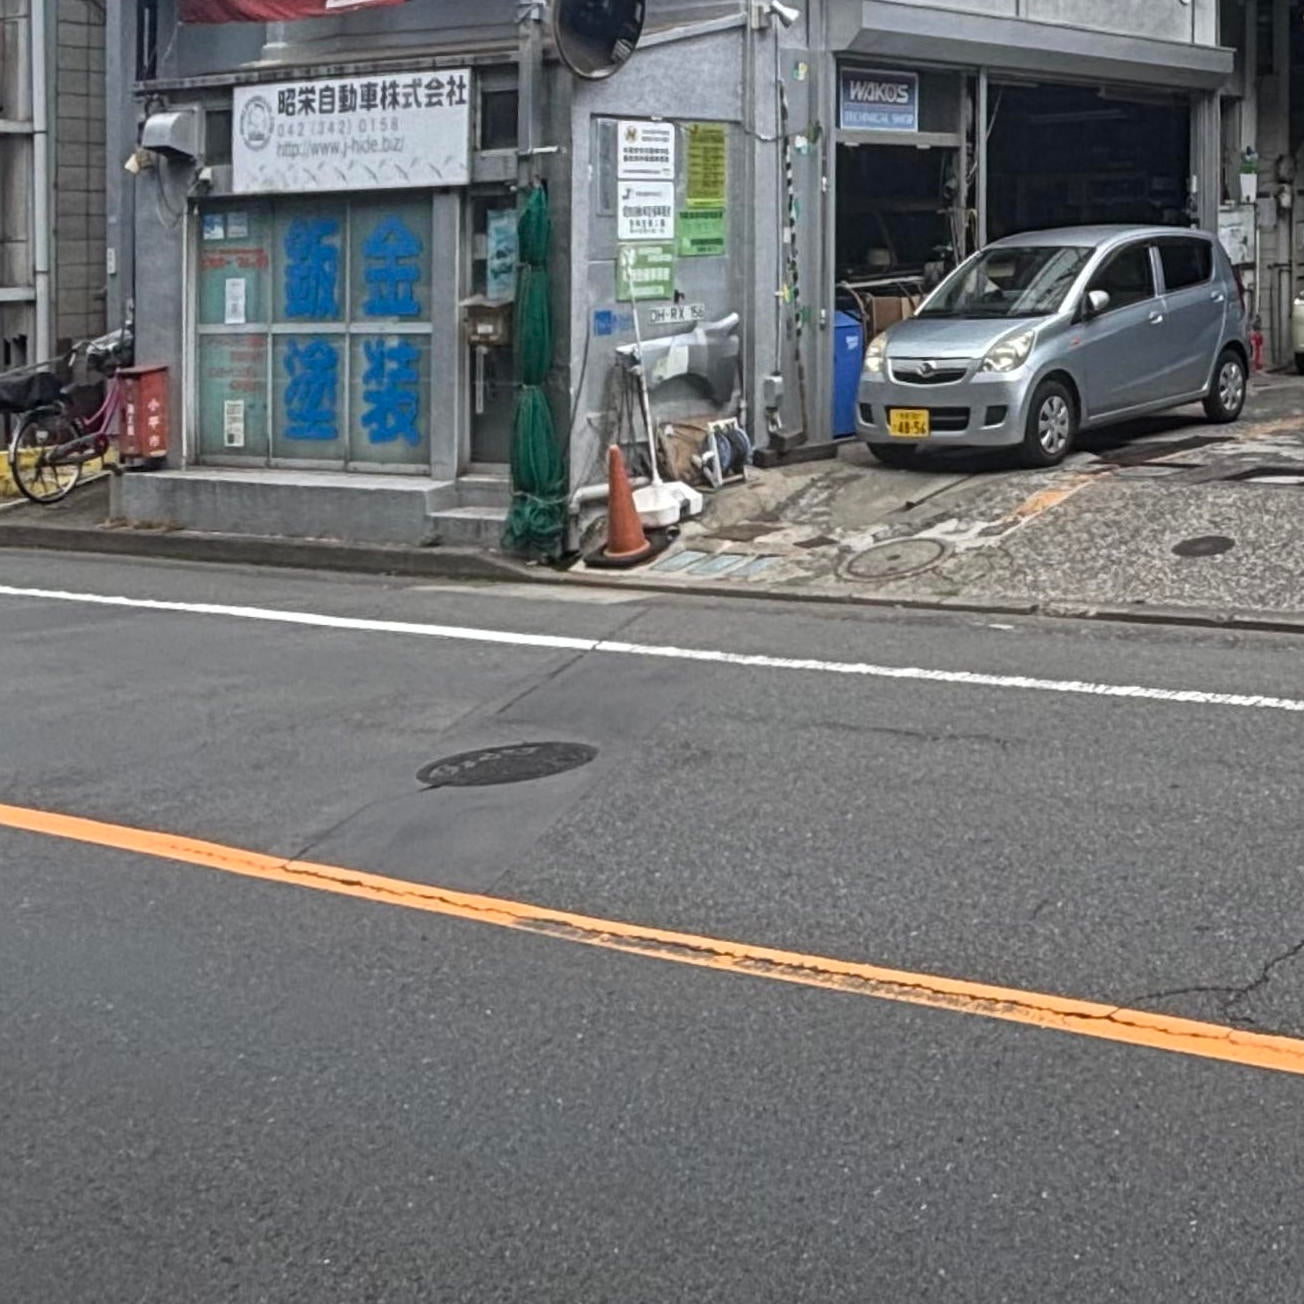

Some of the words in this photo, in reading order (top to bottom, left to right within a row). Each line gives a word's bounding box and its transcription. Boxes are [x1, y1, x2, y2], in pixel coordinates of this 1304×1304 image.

[277, 74, 467, 116] 昭栄自動車株式会社
